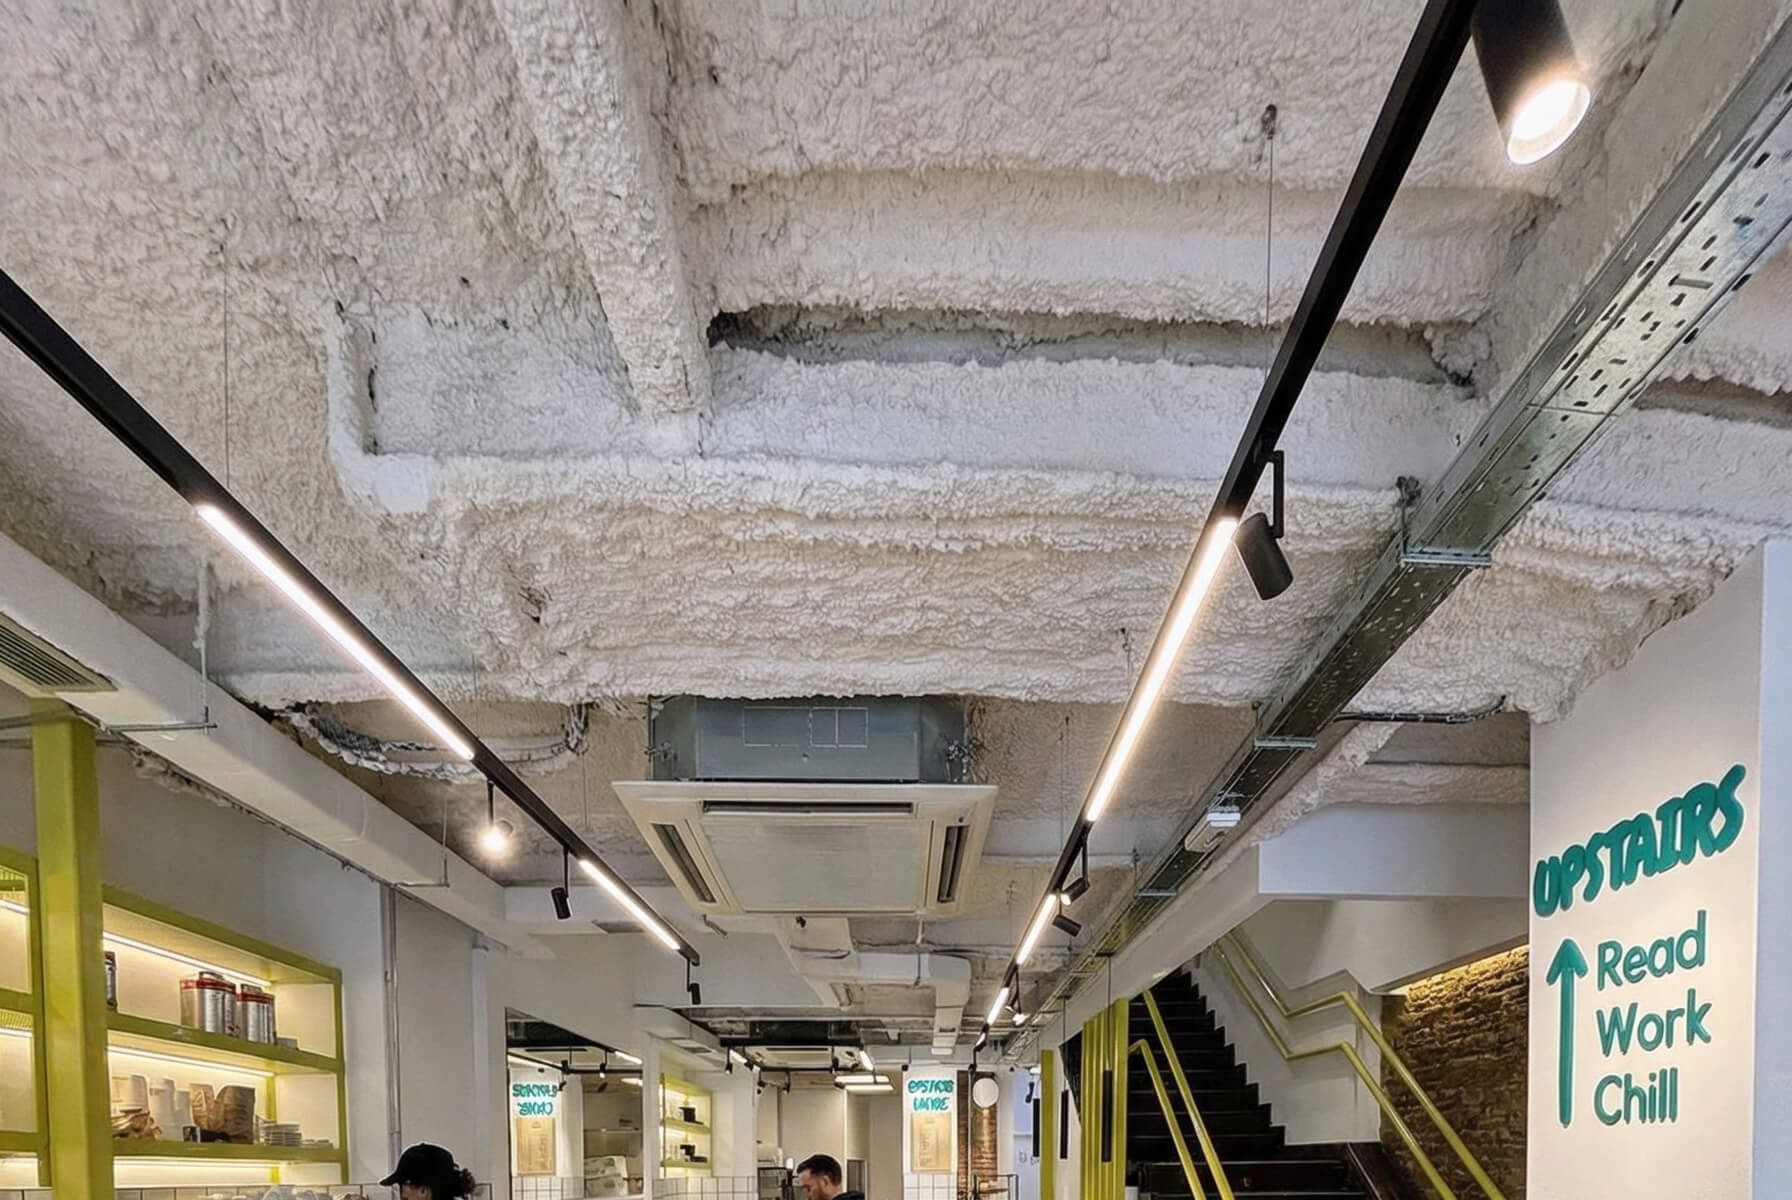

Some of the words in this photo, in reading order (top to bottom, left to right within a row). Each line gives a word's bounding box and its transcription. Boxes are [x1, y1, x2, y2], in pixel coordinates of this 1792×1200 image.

[1532, 763, 1746, 918] UPSTAIRS
[1597, 909, 1708, 991] Read
[1595, 988, 1713, 1058] Work
[1592, 1066, 1680, 1126] Chill
